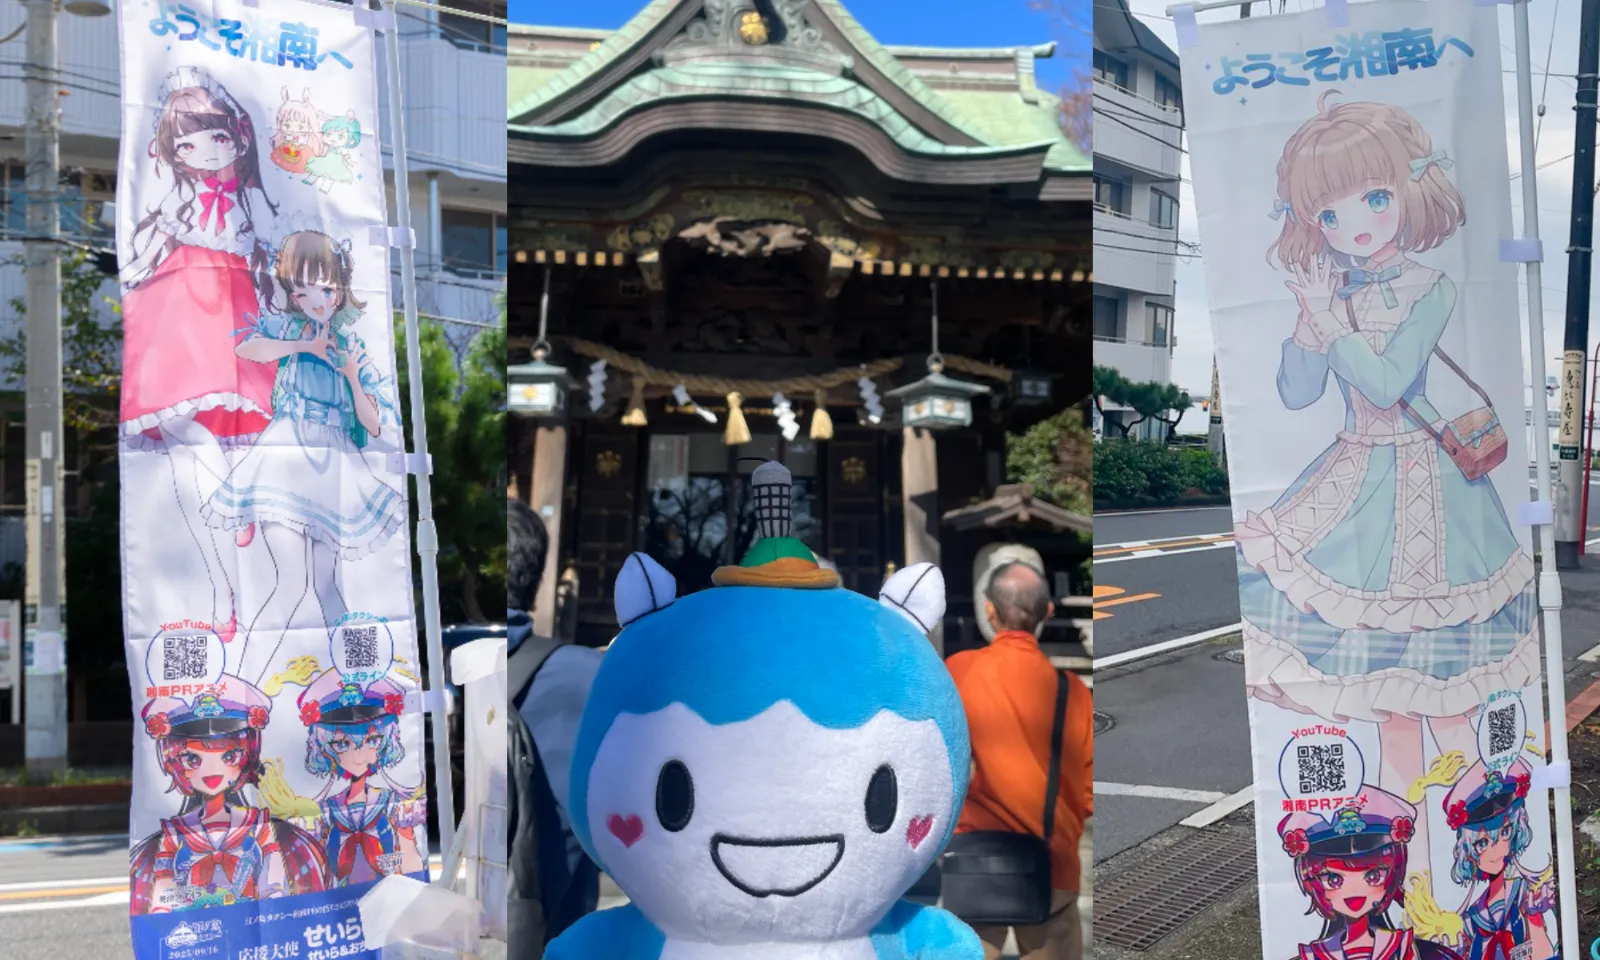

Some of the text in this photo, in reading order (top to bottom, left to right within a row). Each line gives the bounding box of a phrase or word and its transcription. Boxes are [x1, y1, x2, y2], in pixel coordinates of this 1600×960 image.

[149, 3, 354, 70] ようこそ湘南へ
[1213, 27, 1475, 95] ようこそ湘南へ
[160, 619, 213, 631] YouTube
[341, 670, 387, 683] 公式ライン
[146, 682, 228, 698] 湘南PRアニメ
[1291, 725, 1348, 740] YouTube
[1282, 794, 1369, 811] 湘南PRアニメ
[168, 945, 218, 959] 2025/09/16
[239, 941, 299, 960] 応援大使
